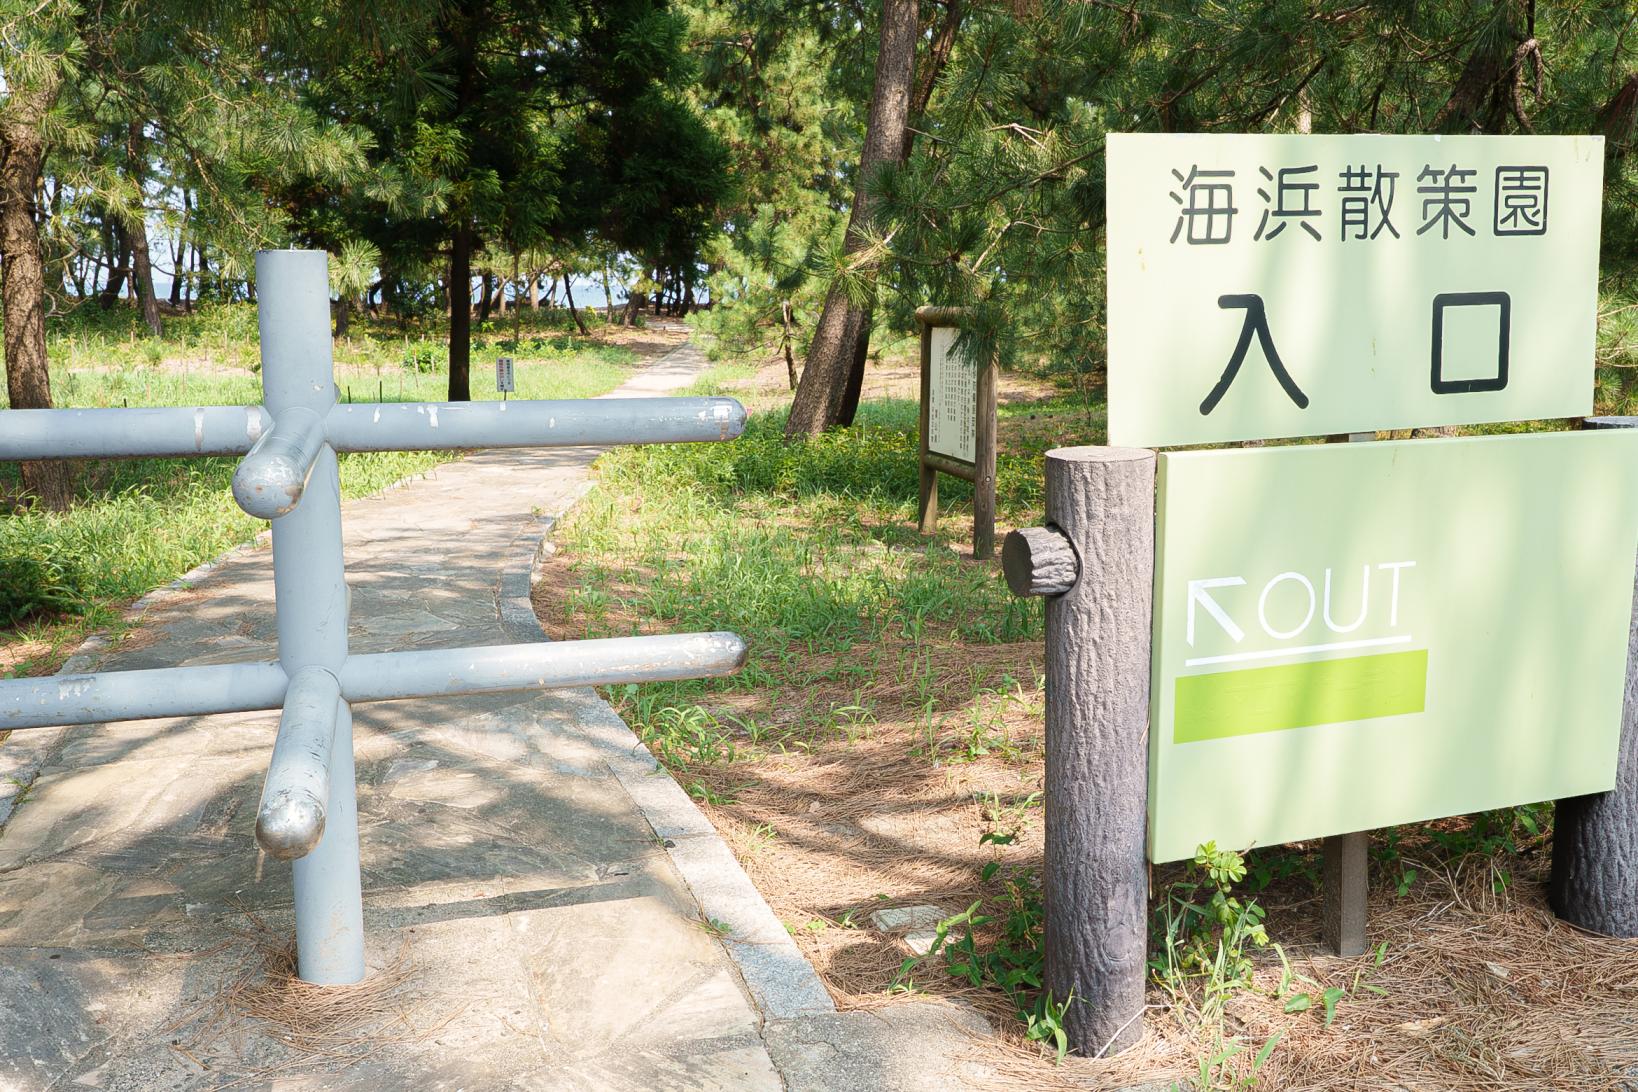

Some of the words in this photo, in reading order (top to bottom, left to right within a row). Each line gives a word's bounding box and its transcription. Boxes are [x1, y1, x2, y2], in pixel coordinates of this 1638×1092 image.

[1169, 163, 1549, 245] 海浜散策園
[1199, 291, 1511, 416] 入口
[1257, 560, 1417, 640] OUT
